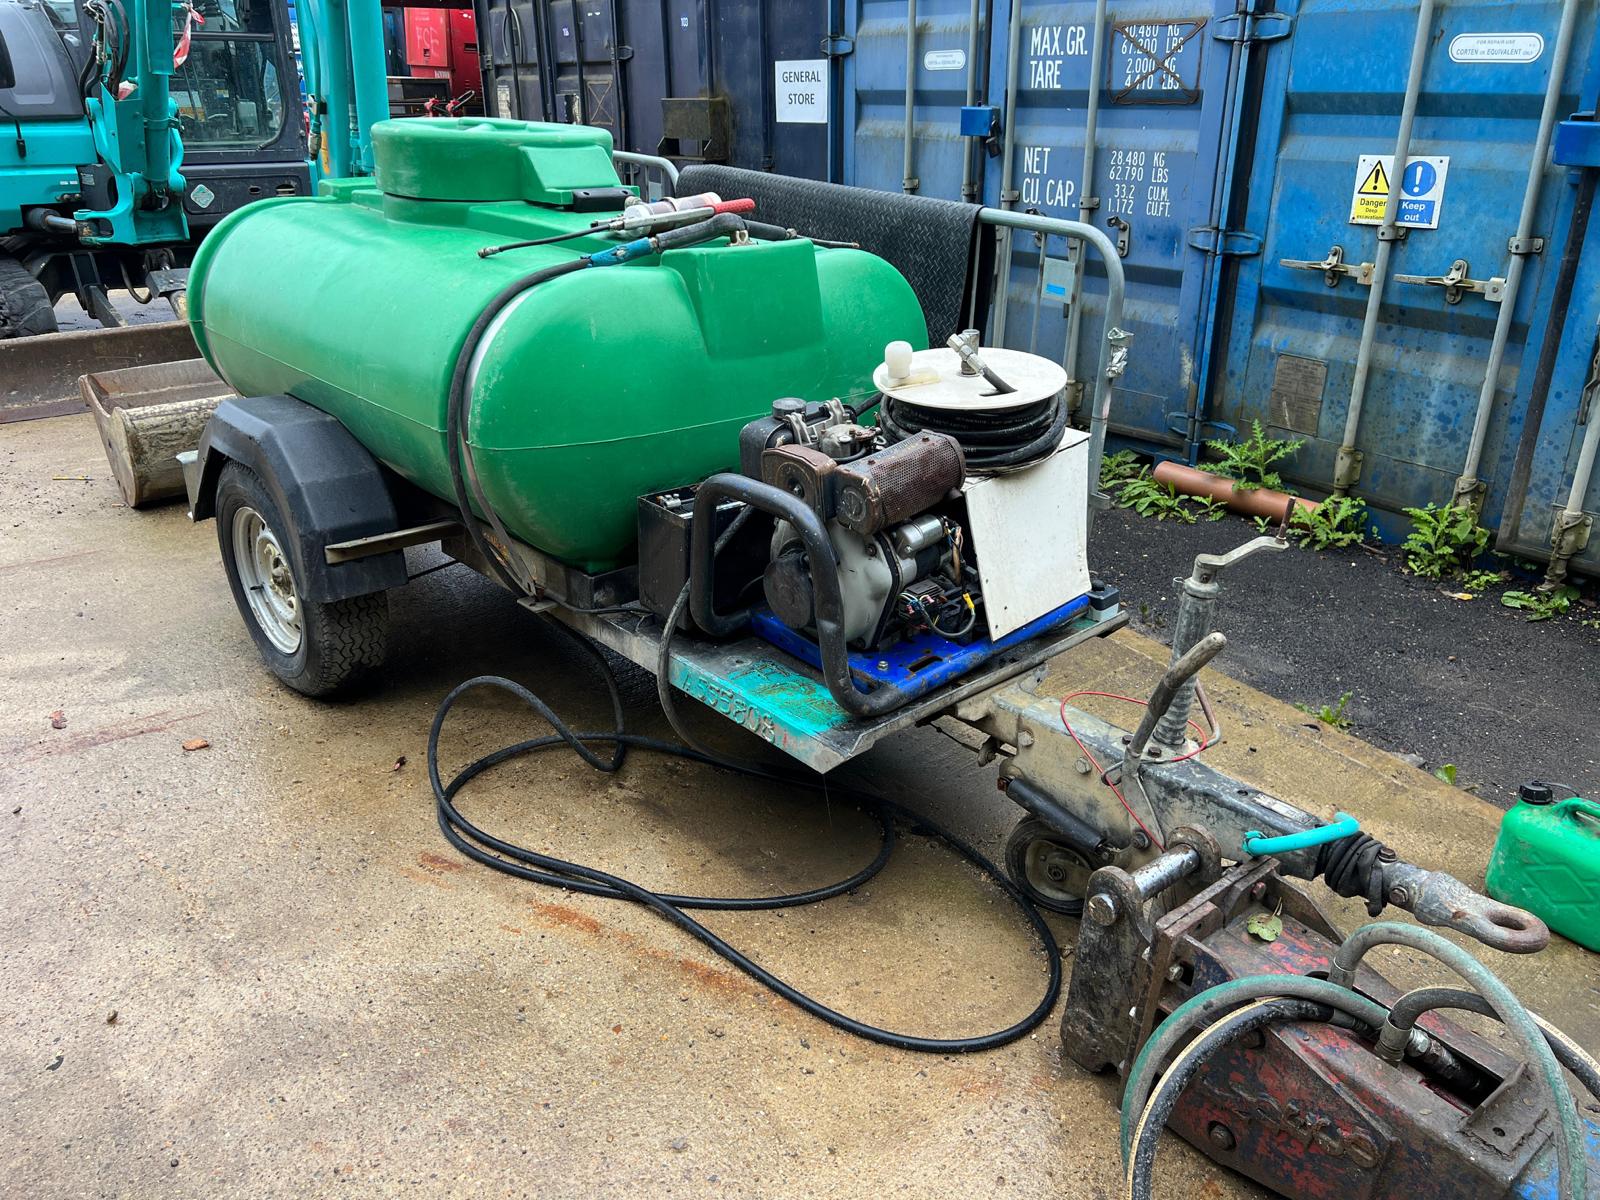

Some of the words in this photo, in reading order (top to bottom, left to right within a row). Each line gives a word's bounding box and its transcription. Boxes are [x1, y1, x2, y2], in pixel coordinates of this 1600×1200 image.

[1456, 48, 1479, 56] CORTEN
[1486, 48, 1522, 56] EQUIVALENT
[1126, 57, 1156, 74] 2.000
[782, 71, 821, 83] GENERAL
[1030, 60, 1063, 89] TARE
[1162, 73, 1180, 90] LBS
[788, 93, 815, 105] STORE
[1023, 147, 1051, 175] NET
[1110, 150, 1146, 167] 28.480
[1153, 152, 1166, 168] KG
[1109, 166, 1144, 182] 62.790
[1151, 168, 1169, 183] LBS
[1022, 177, 1042, 205] CU.
[1046, 179, 1076, 208] CAP.
[1114, 184, 1136, 199] 33.2
[1108, 198, 1134, 215] 1.172
[1359, 198, 1387, 208] Danger
[1402, 201, 1426, 211] Keep
